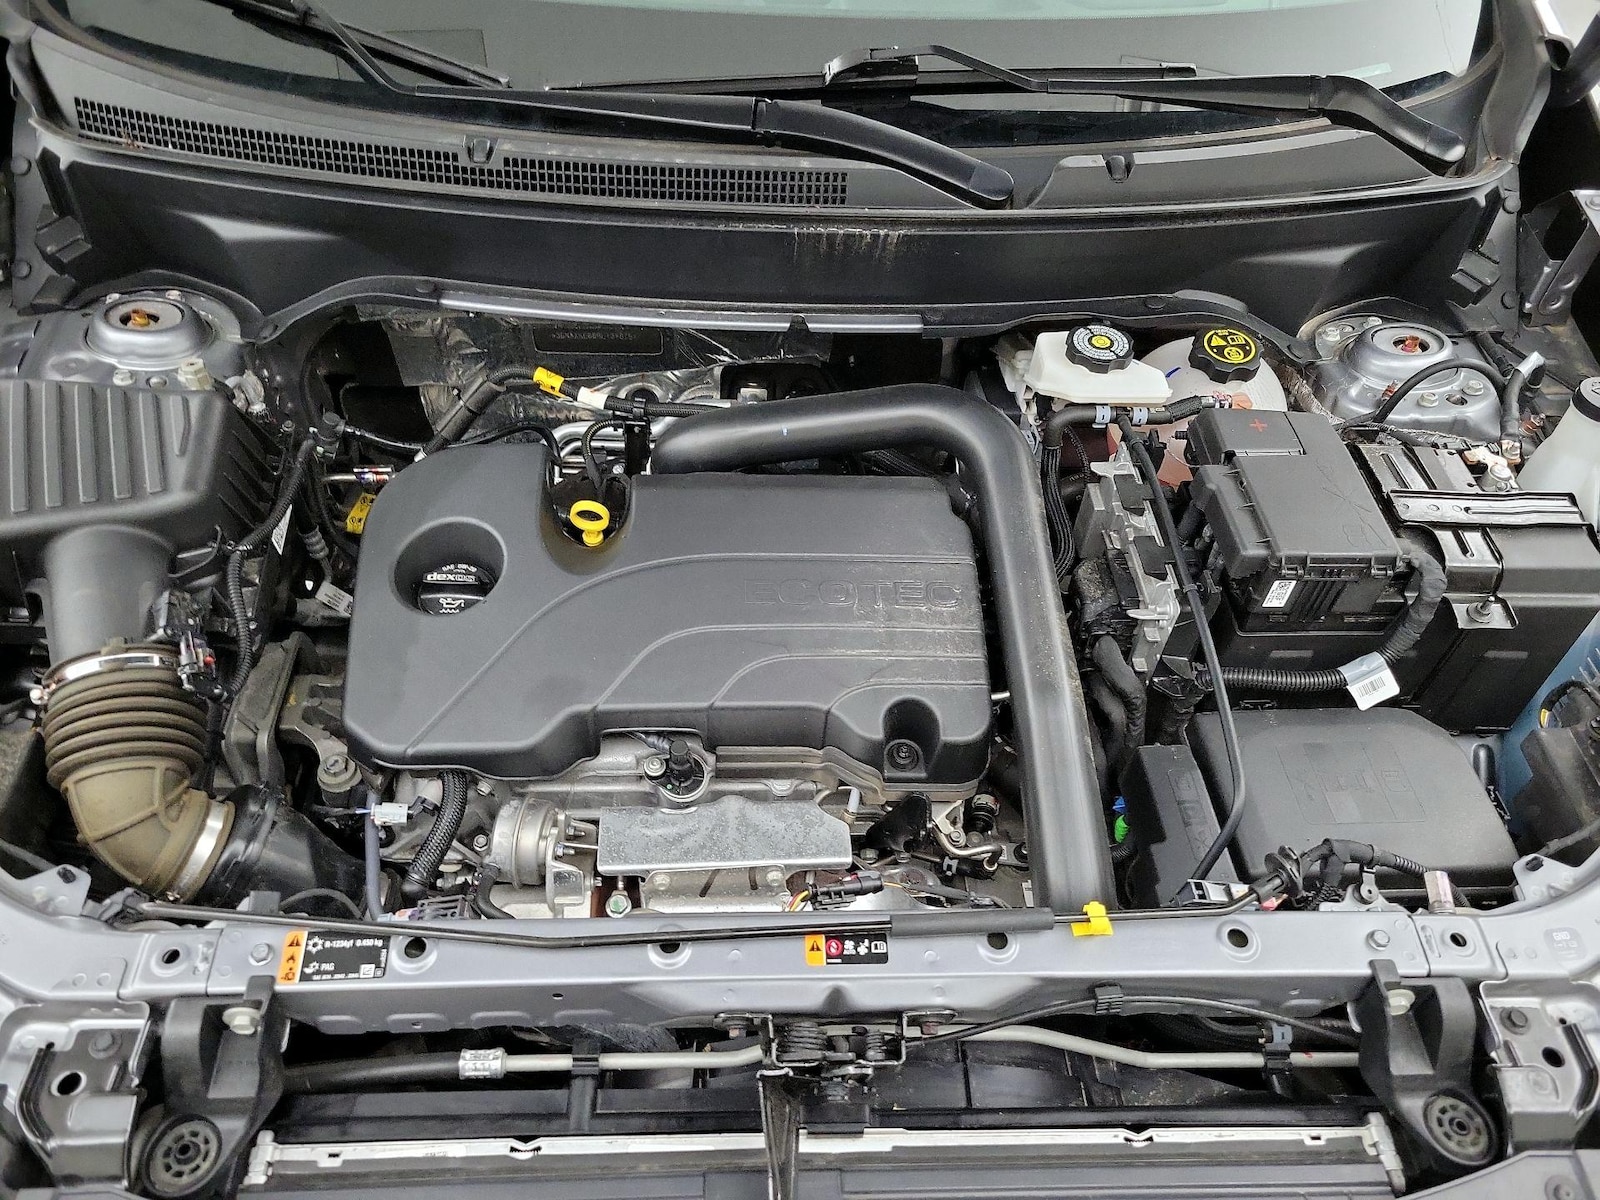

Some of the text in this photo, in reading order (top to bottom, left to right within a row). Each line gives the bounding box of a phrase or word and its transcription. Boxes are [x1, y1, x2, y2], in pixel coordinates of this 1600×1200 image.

[744, 579, 962, 609] ECOTEC
[374, 937, 384, 948] kg
[320, 962, 336, 972] PAG
